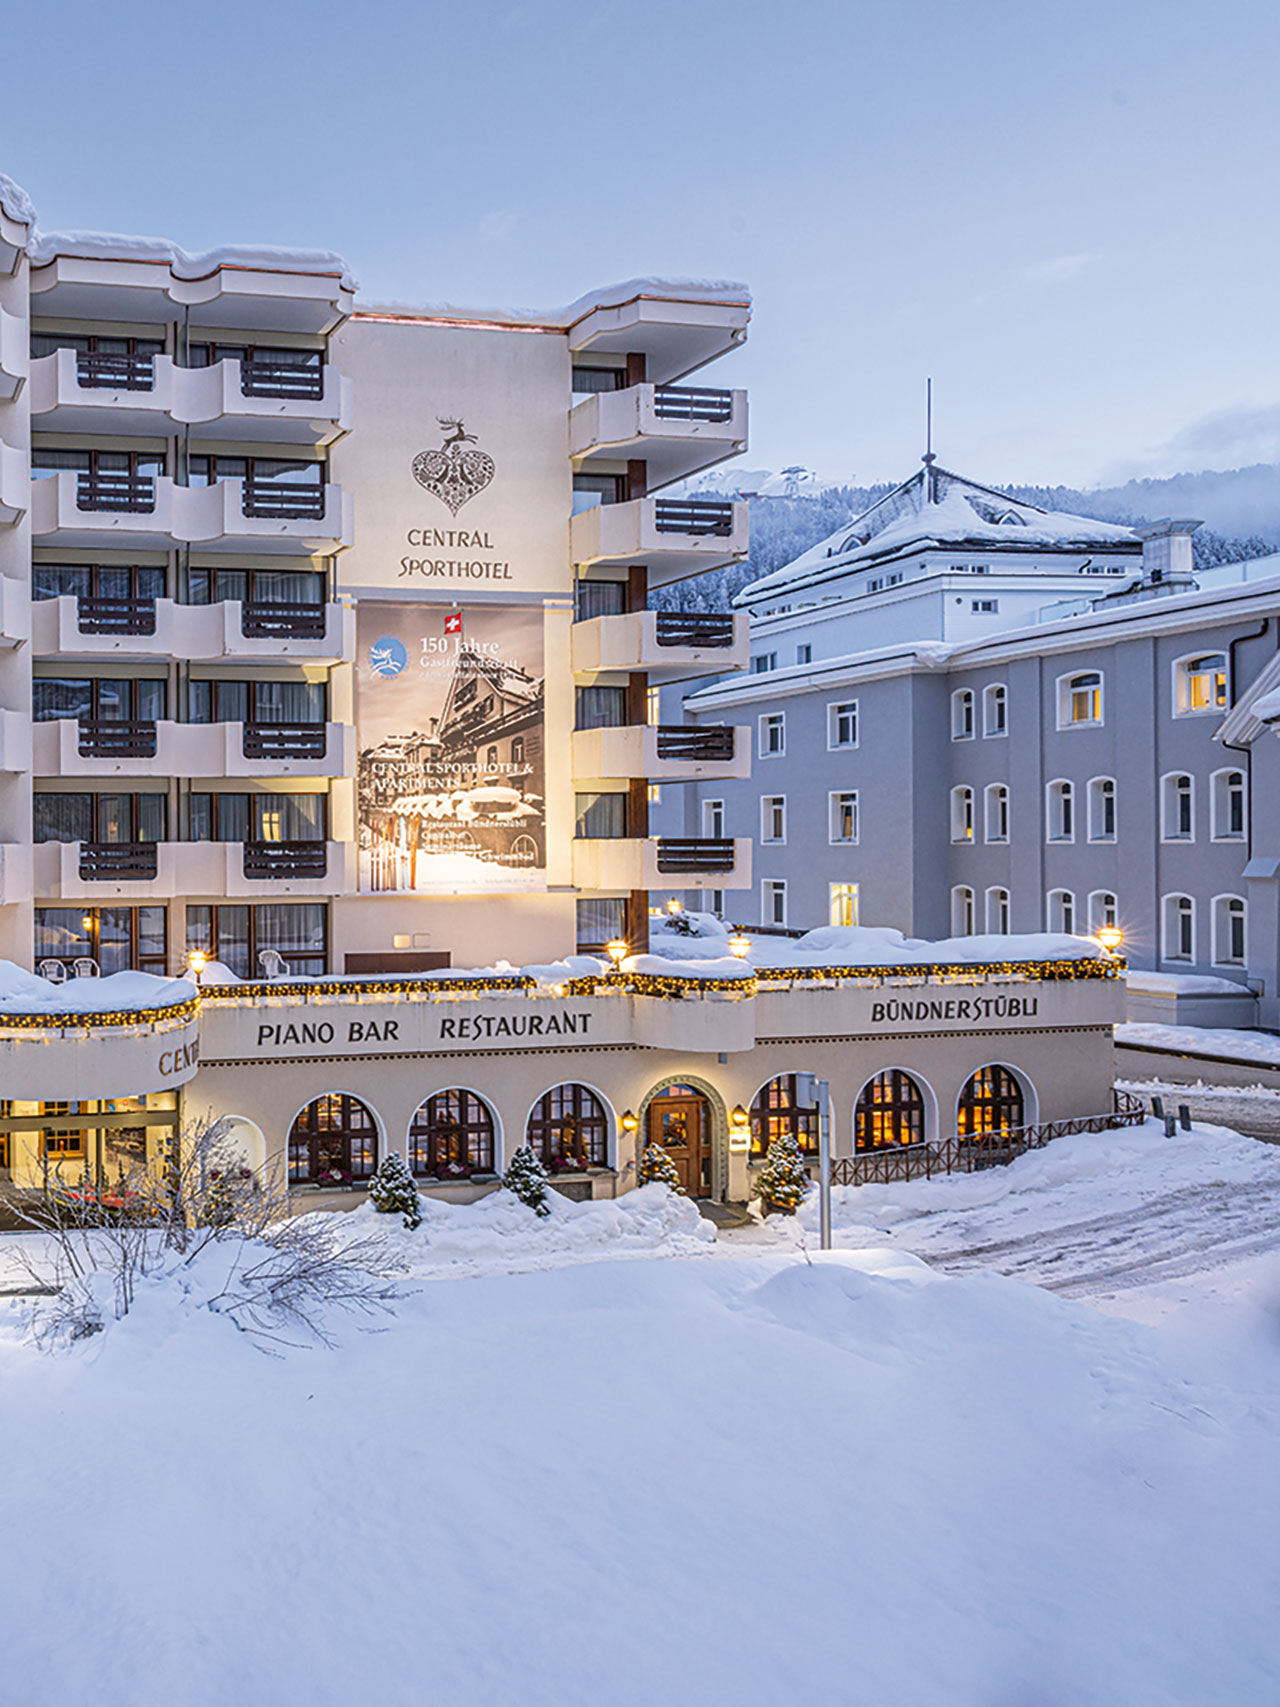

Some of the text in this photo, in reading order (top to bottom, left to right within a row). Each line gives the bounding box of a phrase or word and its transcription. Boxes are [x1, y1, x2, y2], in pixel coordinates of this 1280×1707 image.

[407, 528, 494, 549] CENTRAL
[398, 556, 513, 580] SPORTHOTEL
[420, 637, 499, 657] 150 Jahre
[372, 762, 534, 774] CENTRAL SPORTHOTEL &
[373, 777, 461, 789] APARTMENTS
[871, 995, 1039, 1023] BÜNDNERSTÜBLI
[257, 1020, 400, 1046] PIANO BAR
[439, 1010, 592, 1040] RESTAURANT
